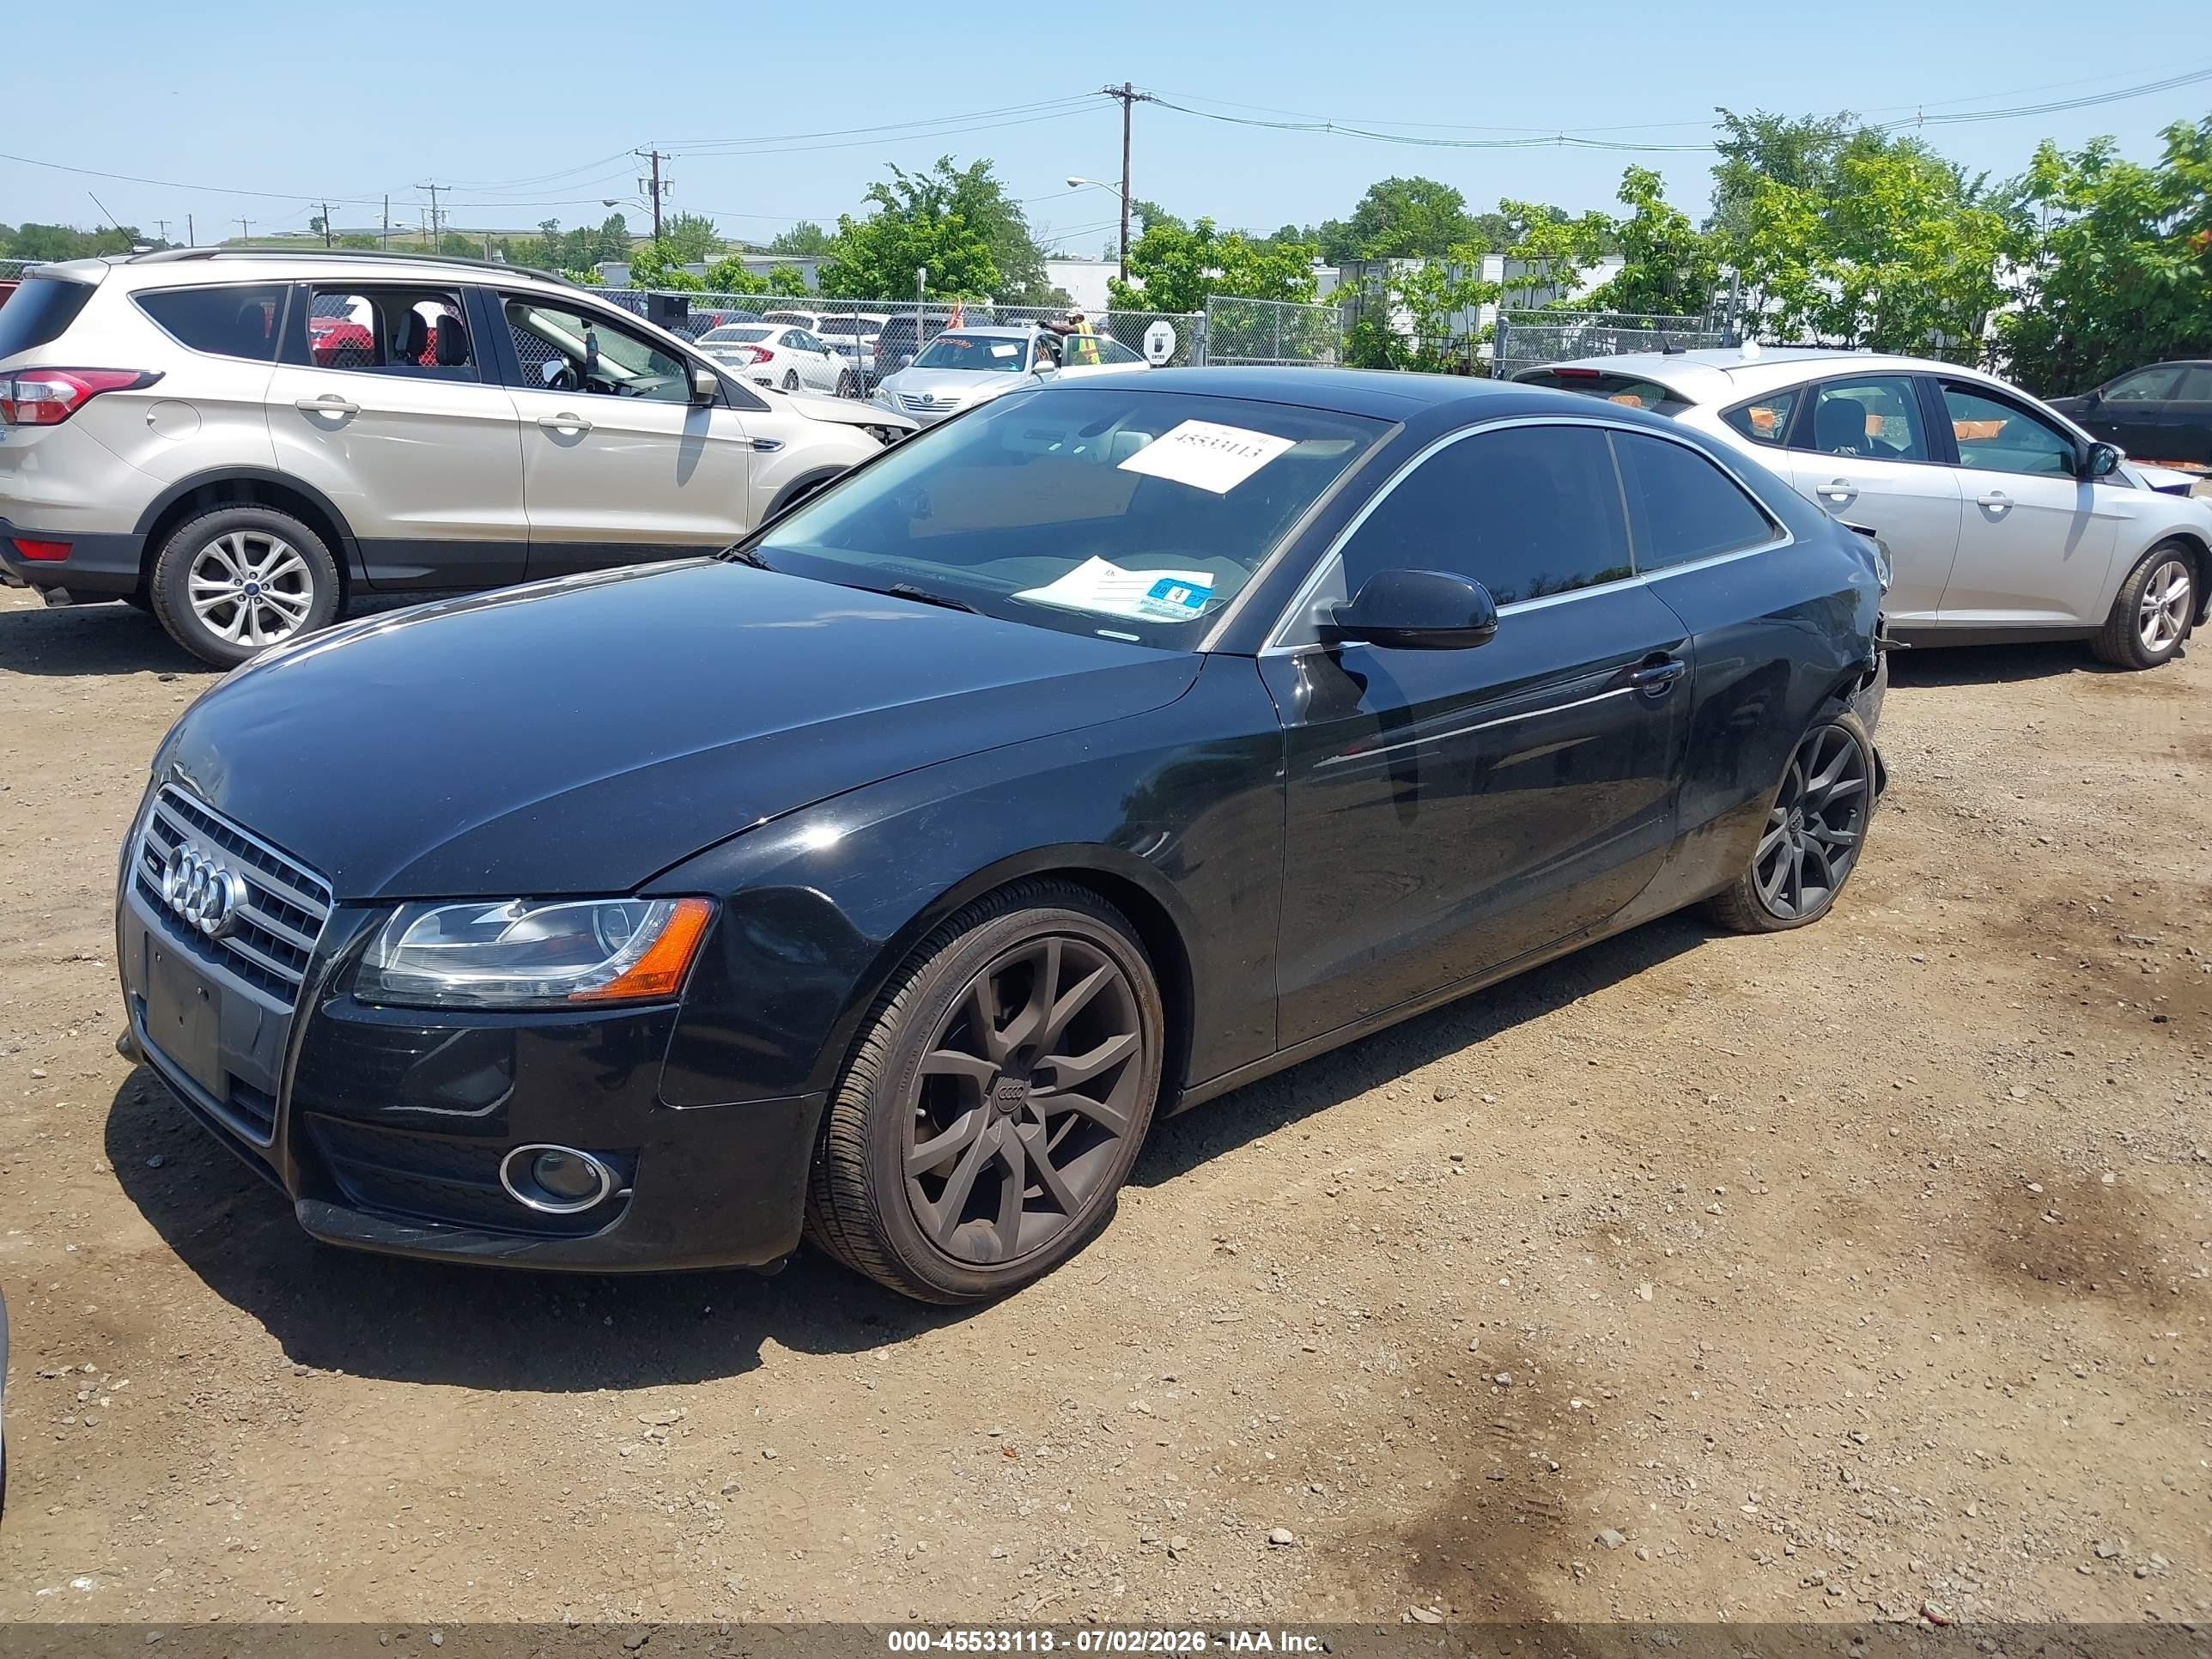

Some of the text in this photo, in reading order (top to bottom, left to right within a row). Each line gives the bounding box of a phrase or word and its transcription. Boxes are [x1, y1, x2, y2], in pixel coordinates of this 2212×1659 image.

[1175, 433, 1263, 458] 45533113
[1153, 585, 1168, 594] 20
[1174, 589, 1184, 600] 4
[1189, 594, 1205, 605] 27
